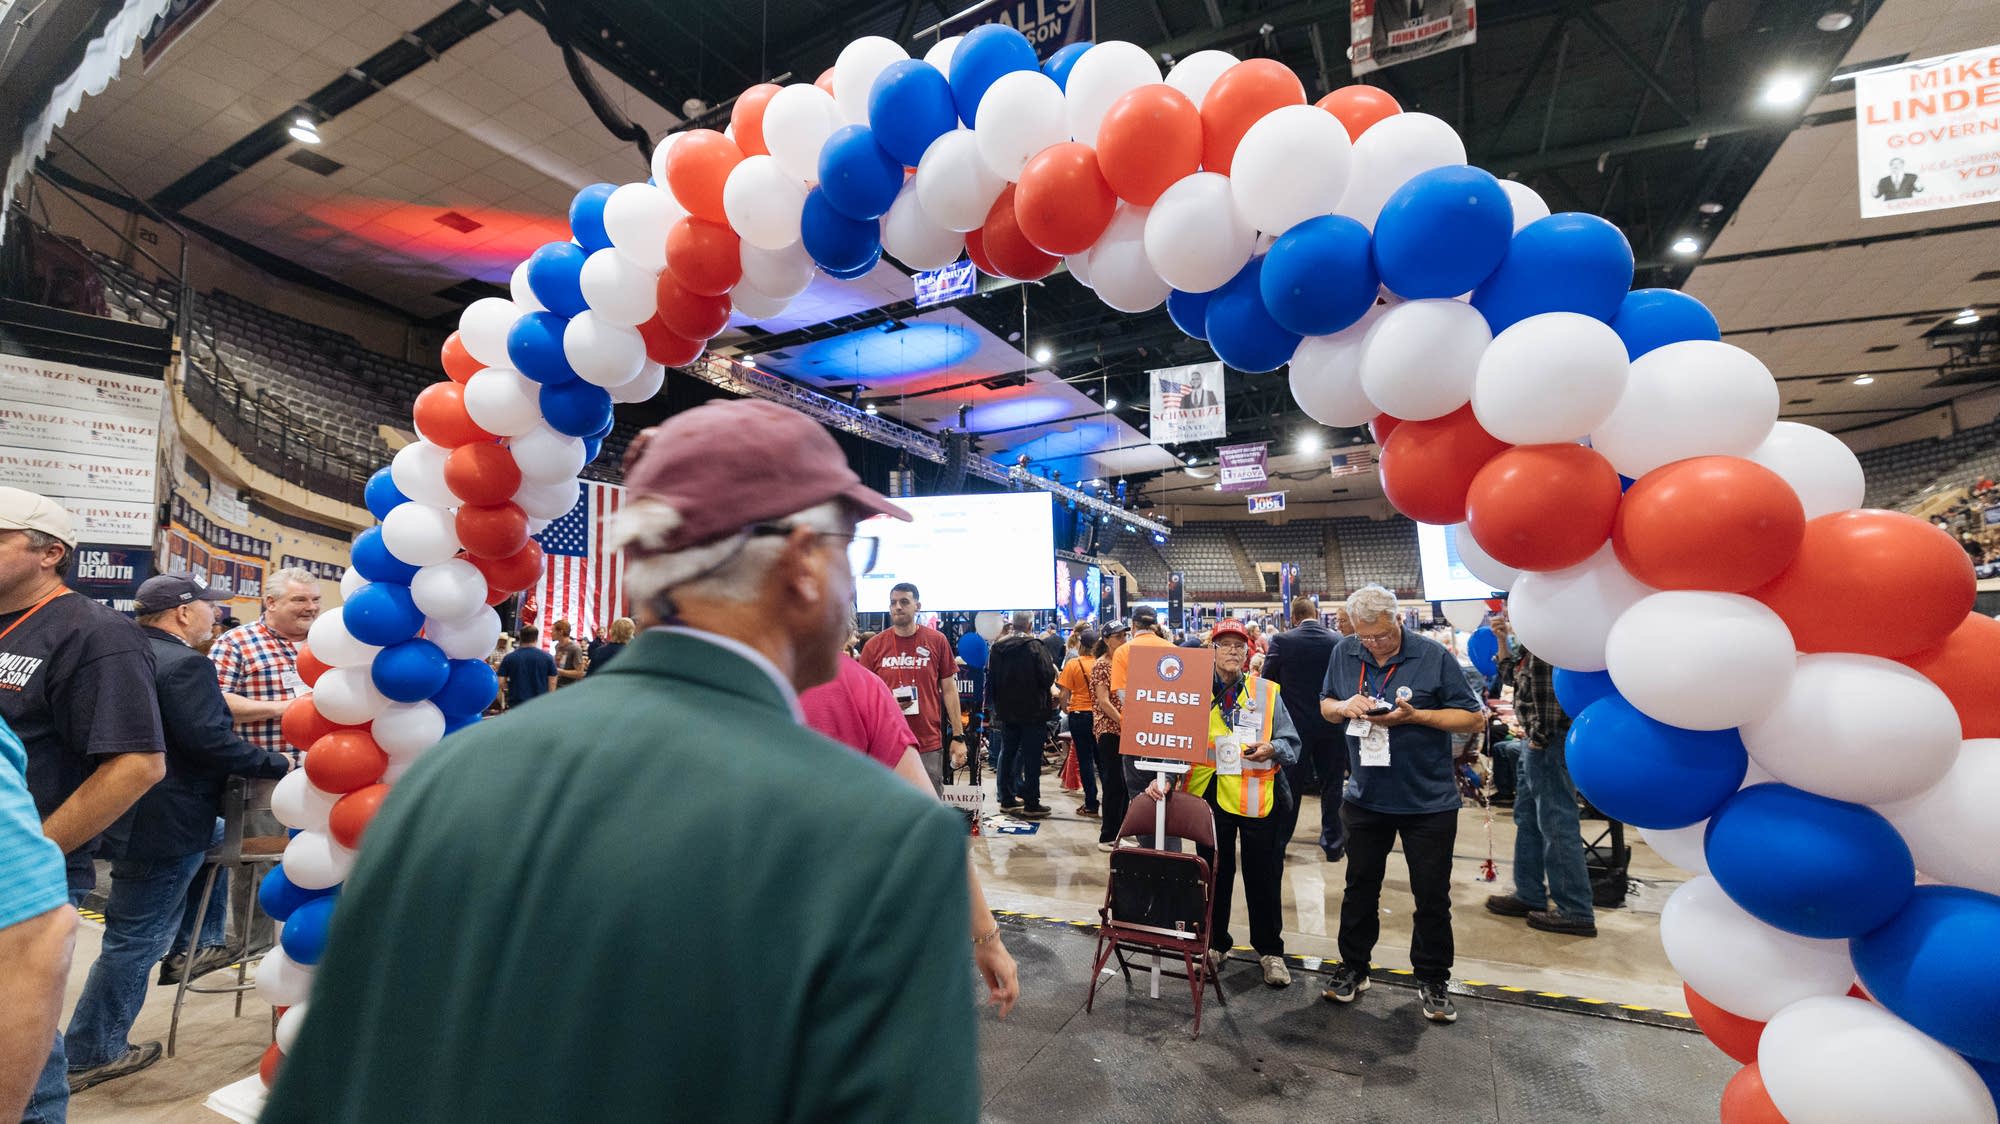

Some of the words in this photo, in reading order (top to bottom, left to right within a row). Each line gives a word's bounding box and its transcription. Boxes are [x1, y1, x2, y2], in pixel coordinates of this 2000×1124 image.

[77, 376, 160, 396] SCHWARZE
[1152, 406, 1223, 421] SCHWARZE
[72, 419, 156, 437] SCHWARZE
[68, 463, 153, 478] SCHWARZE
[79, 550, 110, 565] LISA
[78, 564, 134, 580] DEMUTH
[882, 651, 931, 668] KNIGHT
[1135, 688, 1201, 706] PLEASE
[1152, 711, 1175, 725] BE
[1135, 731, 1193, 750] QUIET!
